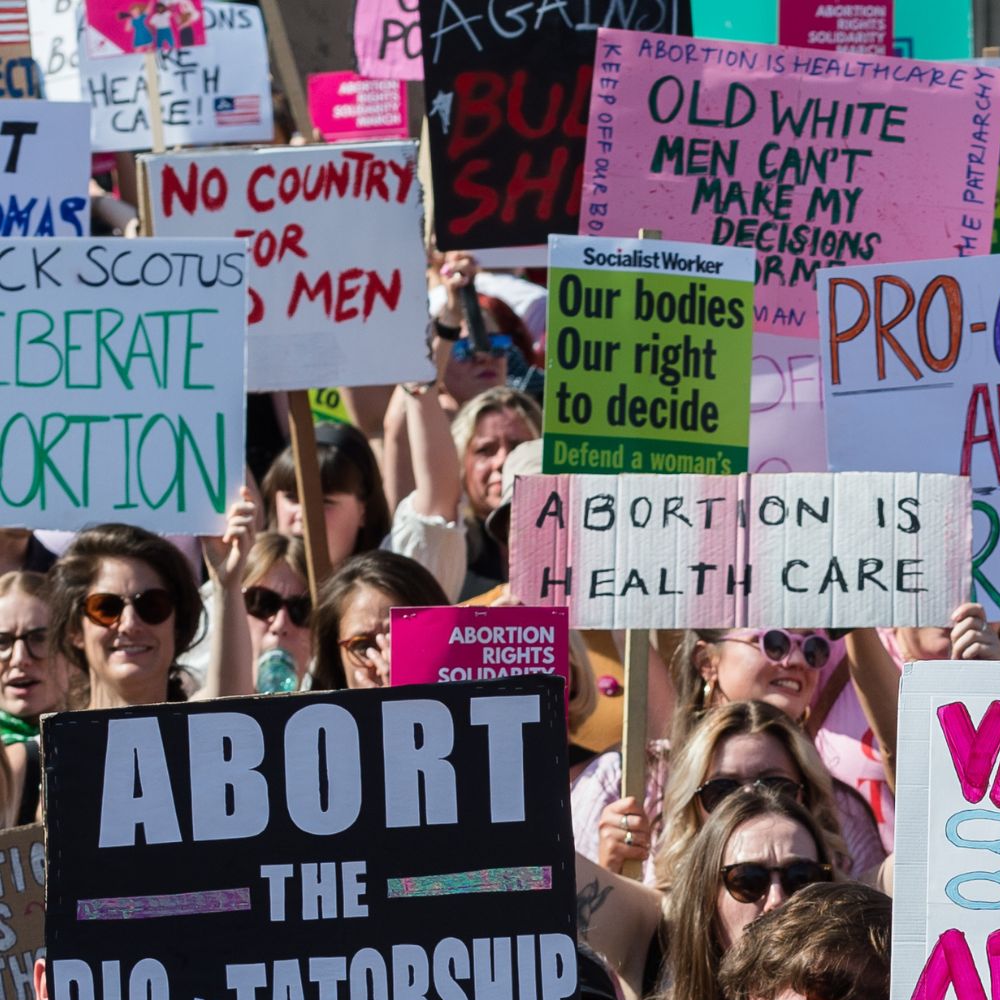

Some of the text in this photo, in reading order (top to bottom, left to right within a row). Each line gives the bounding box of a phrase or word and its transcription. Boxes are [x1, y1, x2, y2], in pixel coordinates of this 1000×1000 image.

[814, 5, 887, 18] ABORTION
[836, 18, 887, 31] RIGHTS
[638, 38, 758, 70] ABORTION
[766, 55, 785, 72] IS
[807, 30, 887, 44] SOLIDARITY
[601, 44, 622, 107] KEEP
[648, 74, 909, 144] OLD WHITE
[596, 112, 613, 154] OFF
[963, 66, 996, 205] PATRIARCHY
[649, 135, 873, 186] MEN CAN'T
[161, 150, 416, 218] NO COUNTRY
[691, 176, 865, 226] MAKE MY
[712, 217, 882, 260] DECISIONS
[76, 245, 245, 288] SCOTUS
[582, 247, 724, 275] Socialist Worker
[286, 267, 402, 323] MEN
[558, 273, 745, 330] Our bodies
[556, 326, 717, 386] Our right
[556, 381, 719, 433] to decide
[553, 440, 624, 469] Defend
[631, 449, 643, 469] a
[651, 449, 732, 476] woman's
[535, 490, 922, 534] ABORTION IS
[540, 555, 929, 599] HEALTH CARE
[448, 625, 556, 645] ABORTION
[482, 646, 556, 665] RIGHTS
[98, 694, 542, 849] ABORT
[259, 860, 370, 923] THE
